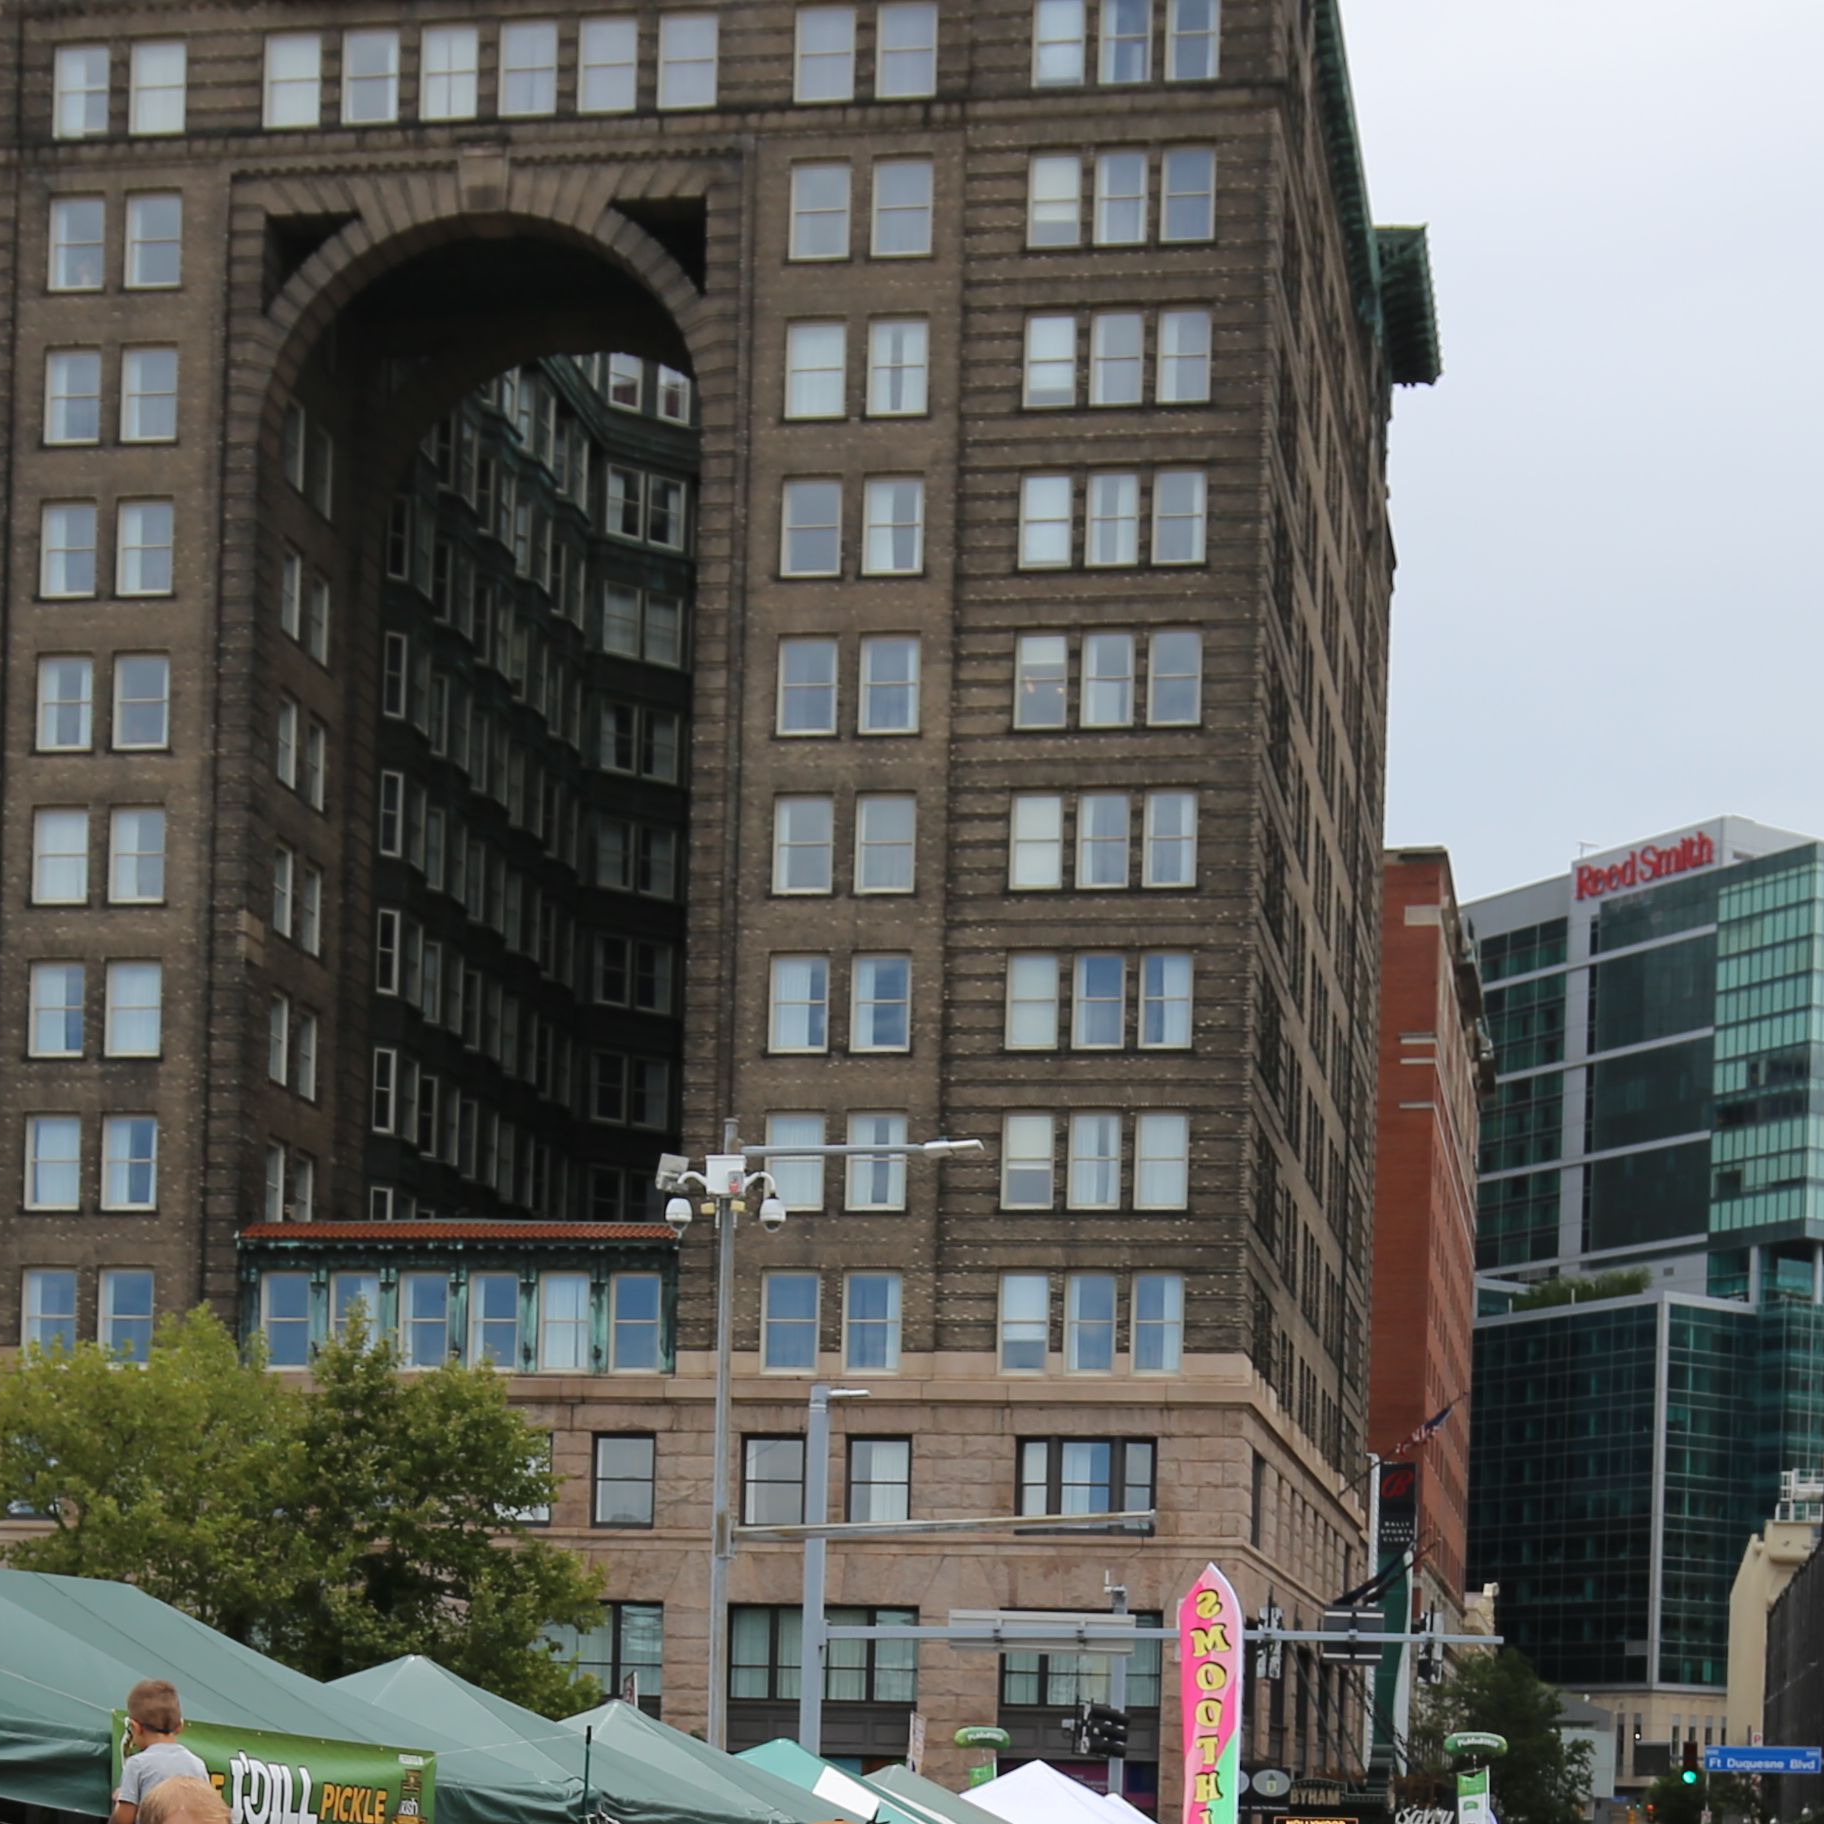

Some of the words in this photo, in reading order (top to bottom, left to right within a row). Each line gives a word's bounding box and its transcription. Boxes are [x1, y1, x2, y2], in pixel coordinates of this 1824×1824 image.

[1575, 850, 1637, 900] Reed
[1639, 831, 1714, 882] Smith
[1709, 1757, 1722, 1769] Ft
[1727, 1758, 1785, 1771] Duquesne
[1789, 1759, 1816, 1771] Blvd
[1289, 1787, 1342, 1806] BYHAM
